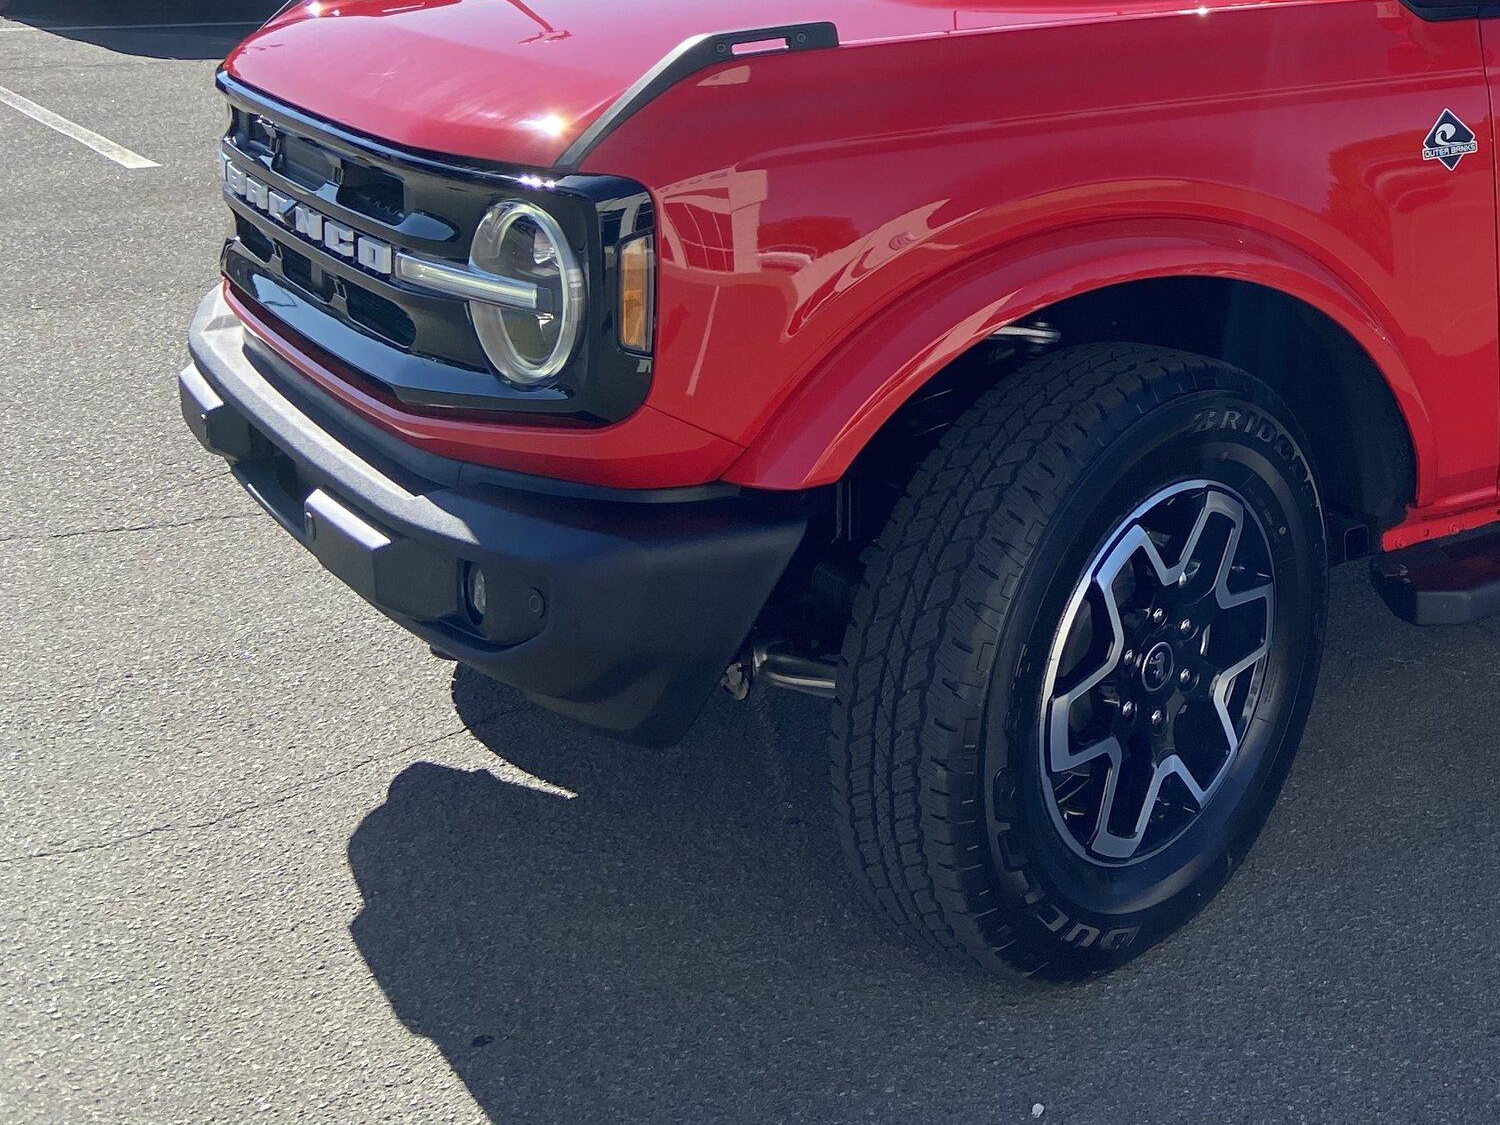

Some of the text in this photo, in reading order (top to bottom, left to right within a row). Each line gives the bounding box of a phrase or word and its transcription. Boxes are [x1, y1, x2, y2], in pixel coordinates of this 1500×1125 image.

[1424, 143, 1476, 158] OUTER BANKS
[226, 160, 393, 275] BRONCO
